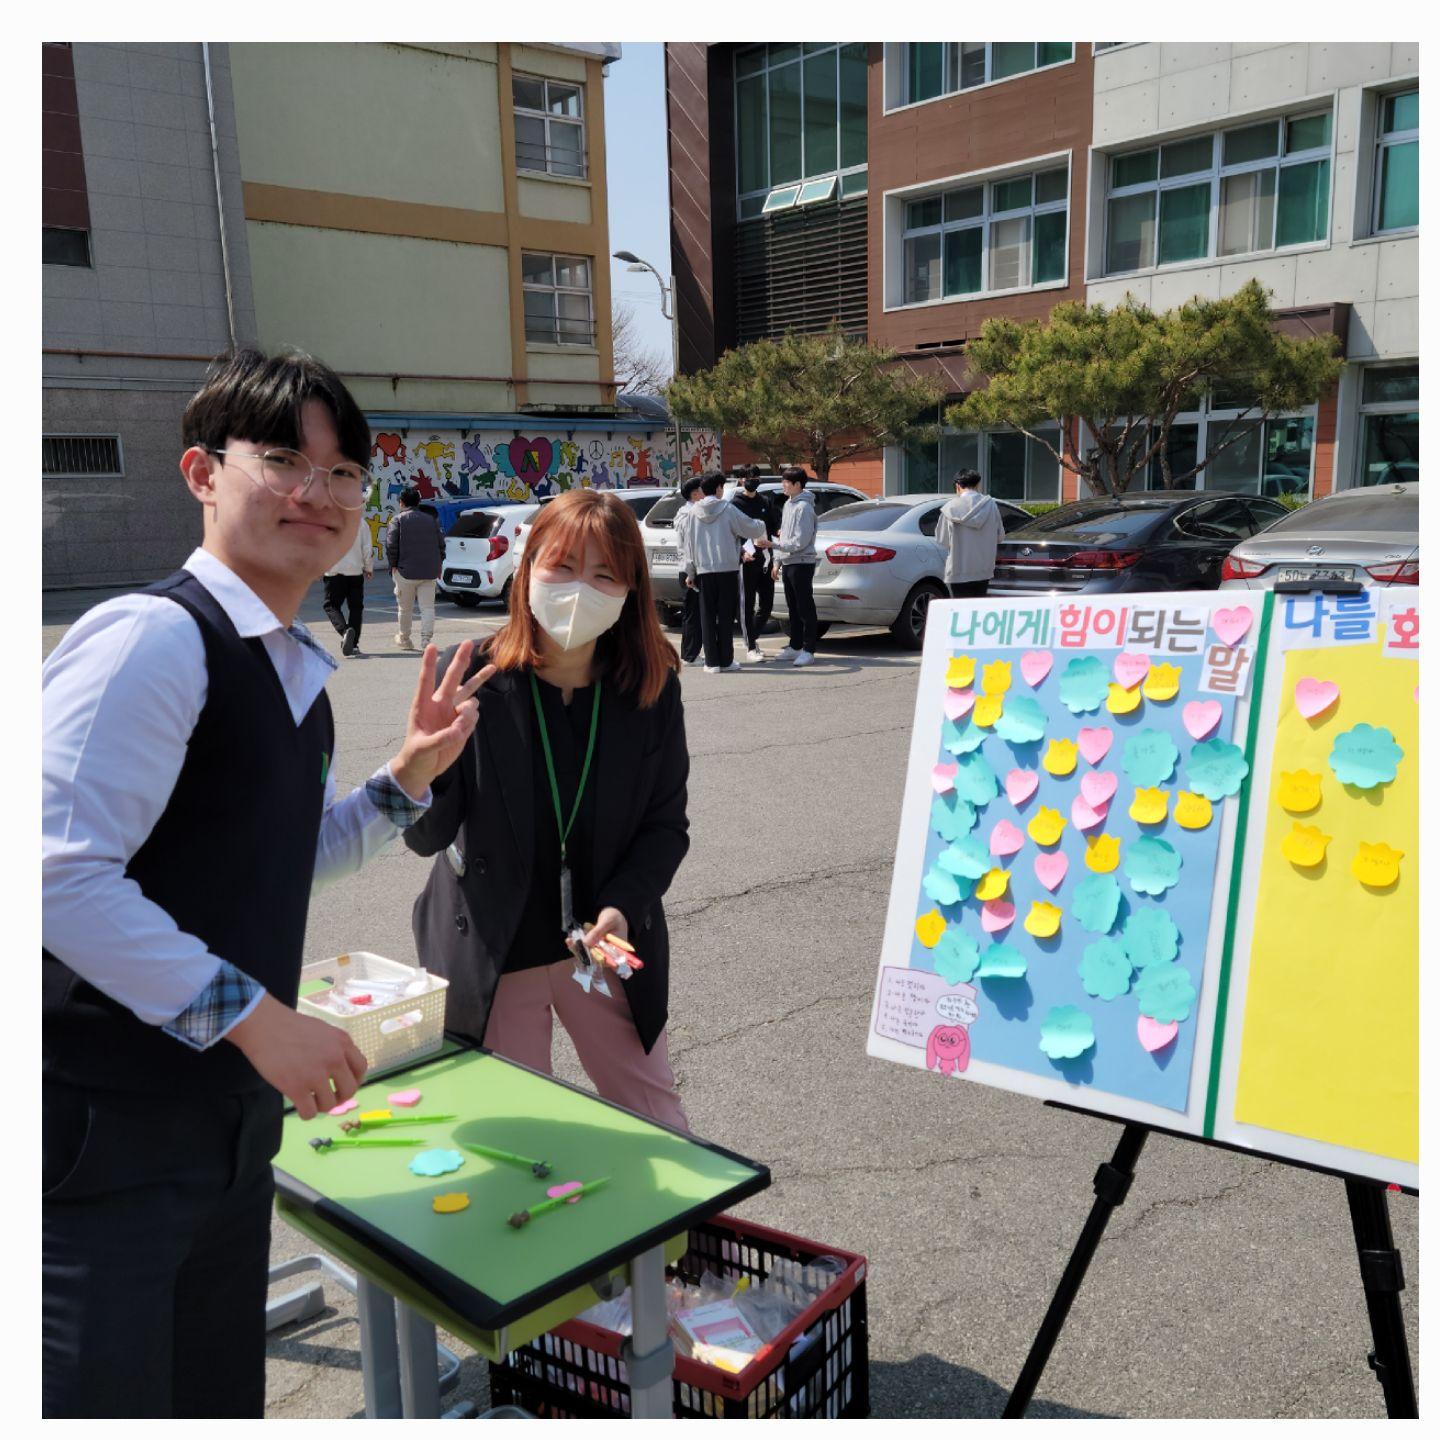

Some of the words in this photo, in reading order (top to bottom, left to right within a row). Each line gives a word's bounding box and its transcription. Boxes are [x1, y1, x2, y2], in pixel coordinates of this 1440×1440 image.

[950, 608, 1051, 646] 나에게
[1285, 591, 1376, 641] 나를
[1207, 645, 1250, 692] 말
